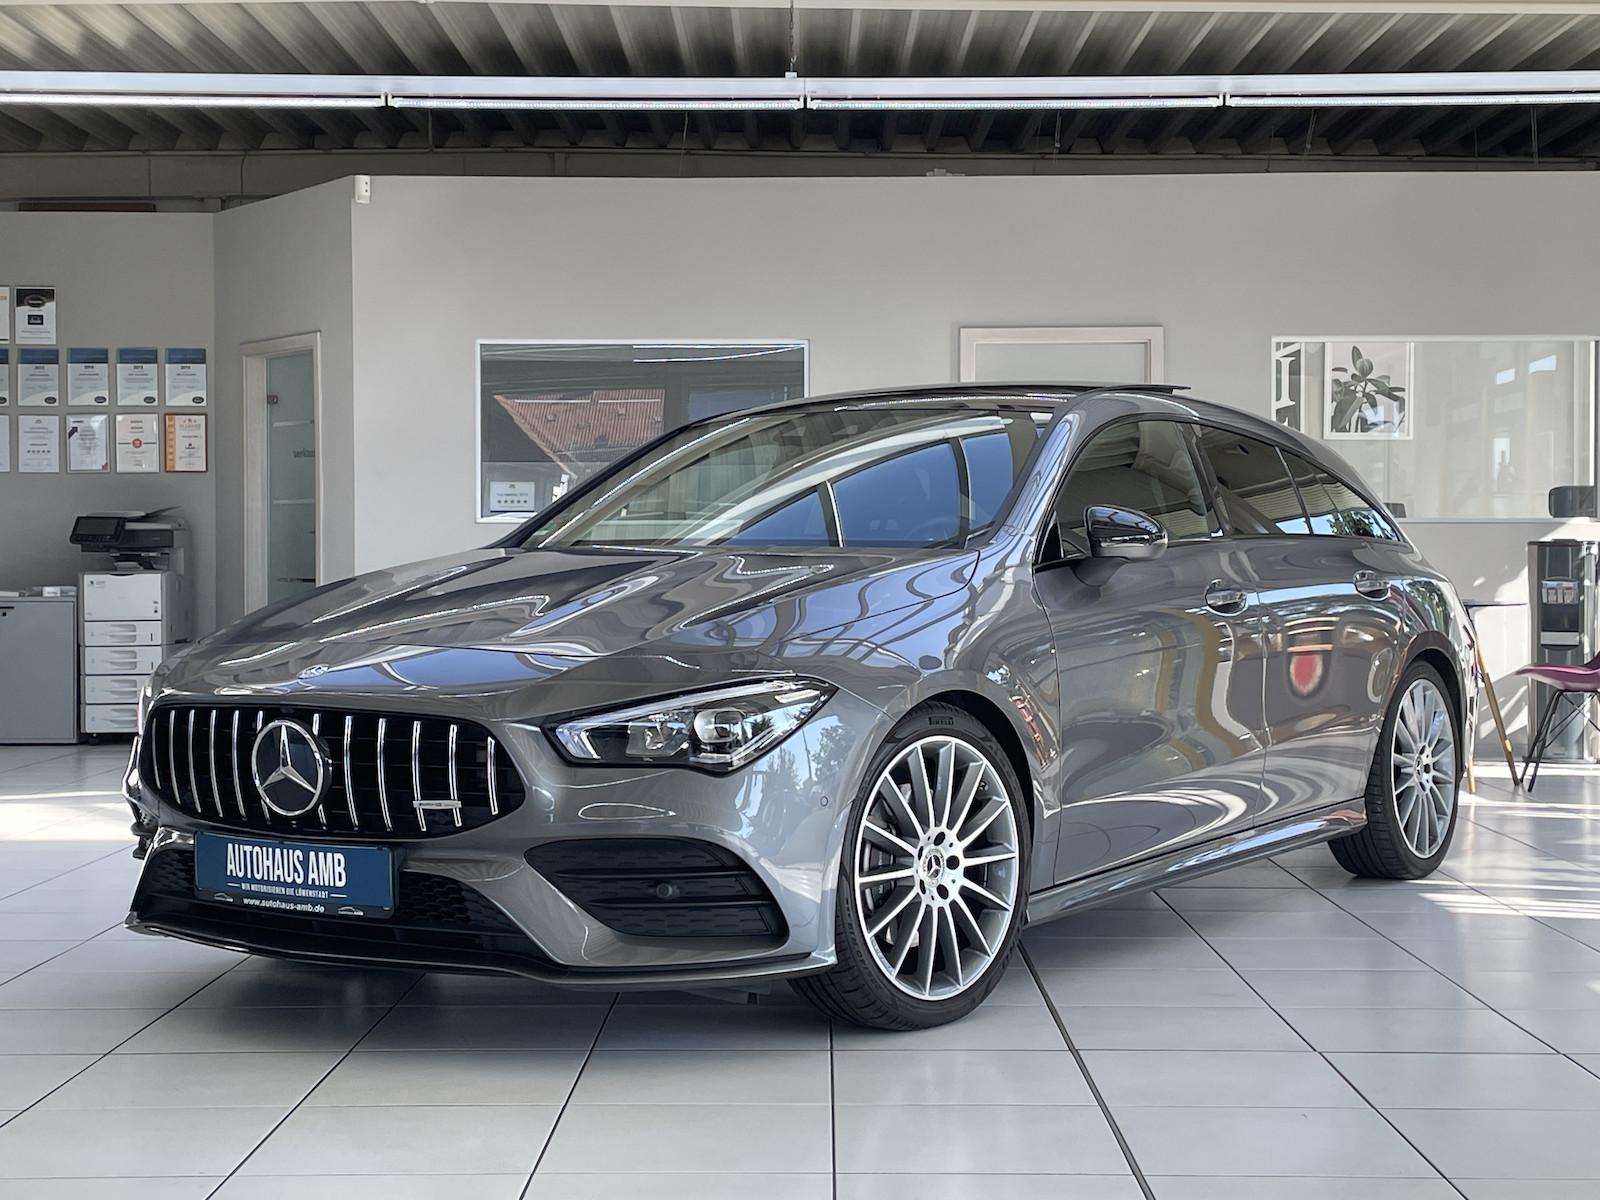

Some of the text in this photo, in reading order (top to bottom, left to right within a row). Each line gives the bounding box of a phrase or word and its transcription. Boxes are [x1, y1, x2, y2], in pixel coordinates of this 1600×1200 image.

[226, 842, 346, 887] AUTOHAUS AMB
[243, 898, 325, 913] www.autohaus-amb.de
